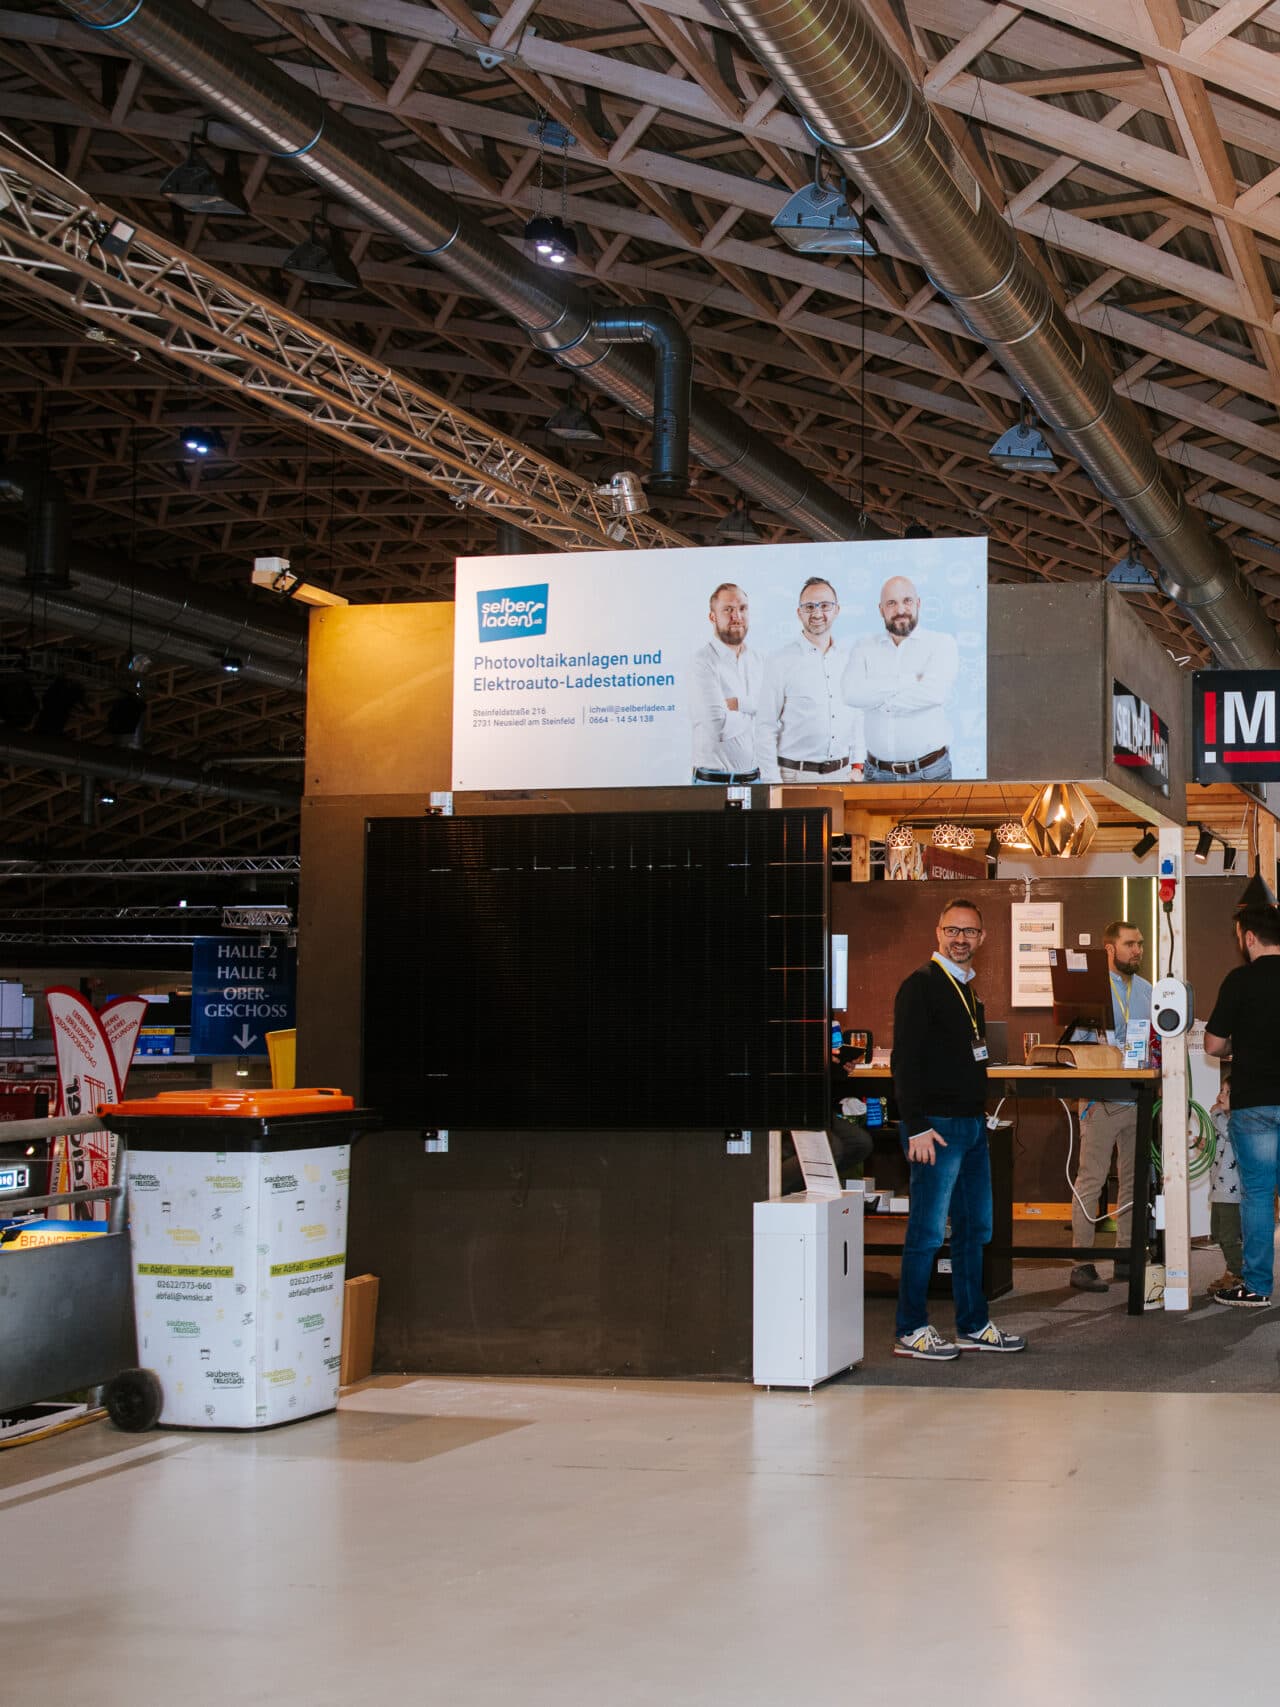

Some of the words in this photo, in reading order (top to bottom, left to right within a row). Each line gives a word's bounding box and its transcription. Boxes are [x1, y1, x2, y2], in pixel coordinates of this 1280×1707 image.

[481, 598, 535, 613] selber
[473, 653, 628, 670] Photovoltaikanlagen
[634, 650, 662, 664] und
[473, 673, 675, 691] Elektroauto-Ladestationen
[541, 717, 575, 726] Steinfeld
[616, 715, 625, 723] 14
[627, 715, 637, 723] 54
[217, 945, 265, 958] HALLE
[217, 966, 265, 979] HALLE
[268, 967, 277, 979] 4
[223, 987, 270, 1000] OBER-
[204, 1003, 287, 1017] GESCHOSS
[138, 1264, 150, 1273] Ihr
[150, 1265, 172, 1274] Abfall
[200, 1266, 233, 1276] Service!
